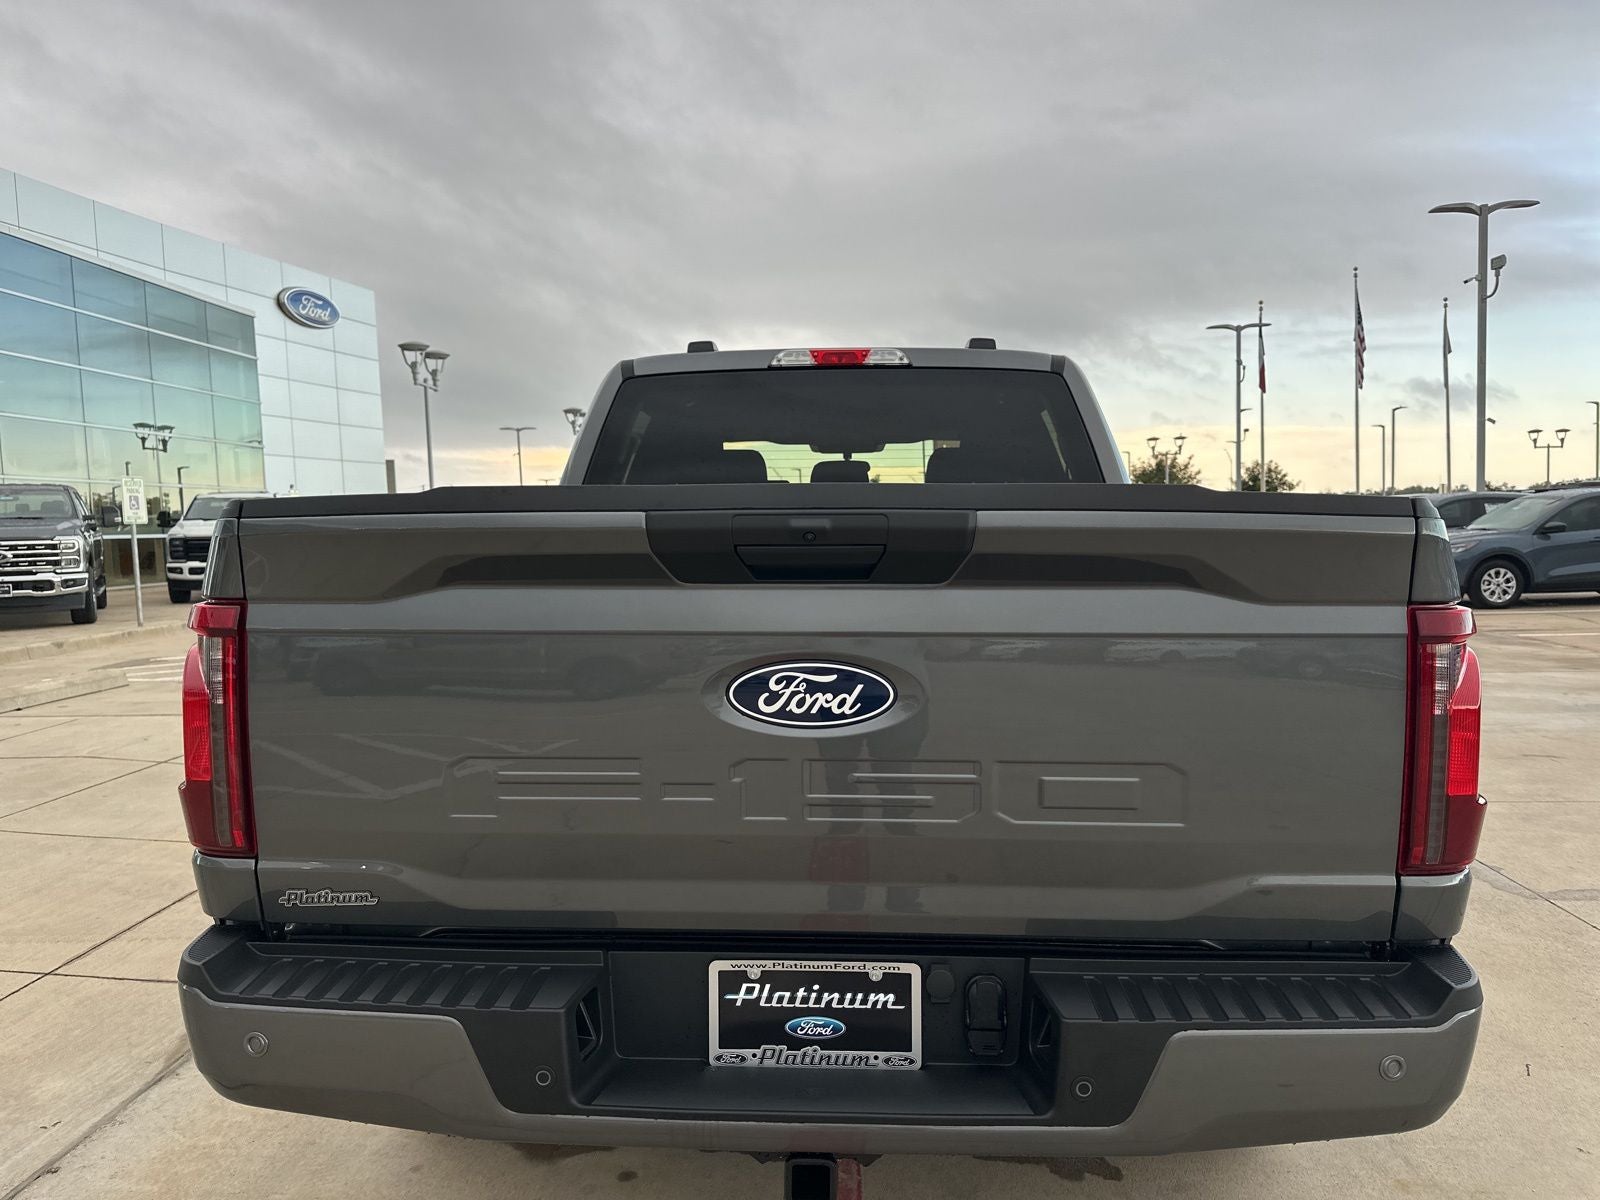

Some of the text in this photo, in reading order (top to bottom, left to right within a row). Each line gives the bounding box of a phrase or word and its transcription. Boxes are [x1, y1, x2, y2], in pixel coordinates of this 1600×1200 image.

[299, 295, 331, 321] Ford
[757, 671, 865, 715] Ford
[446, 756, 1188, 827] F-150
[278, 889, 380, 907] Platinum
[730, 961, 901, 972] www.PlatinumFord.com
[723, 982, 906, 1010] Platinum
[796, 1020, 833, 1036] Ford
[720, 1044, 912, 1068] Ford Platinum Ford
